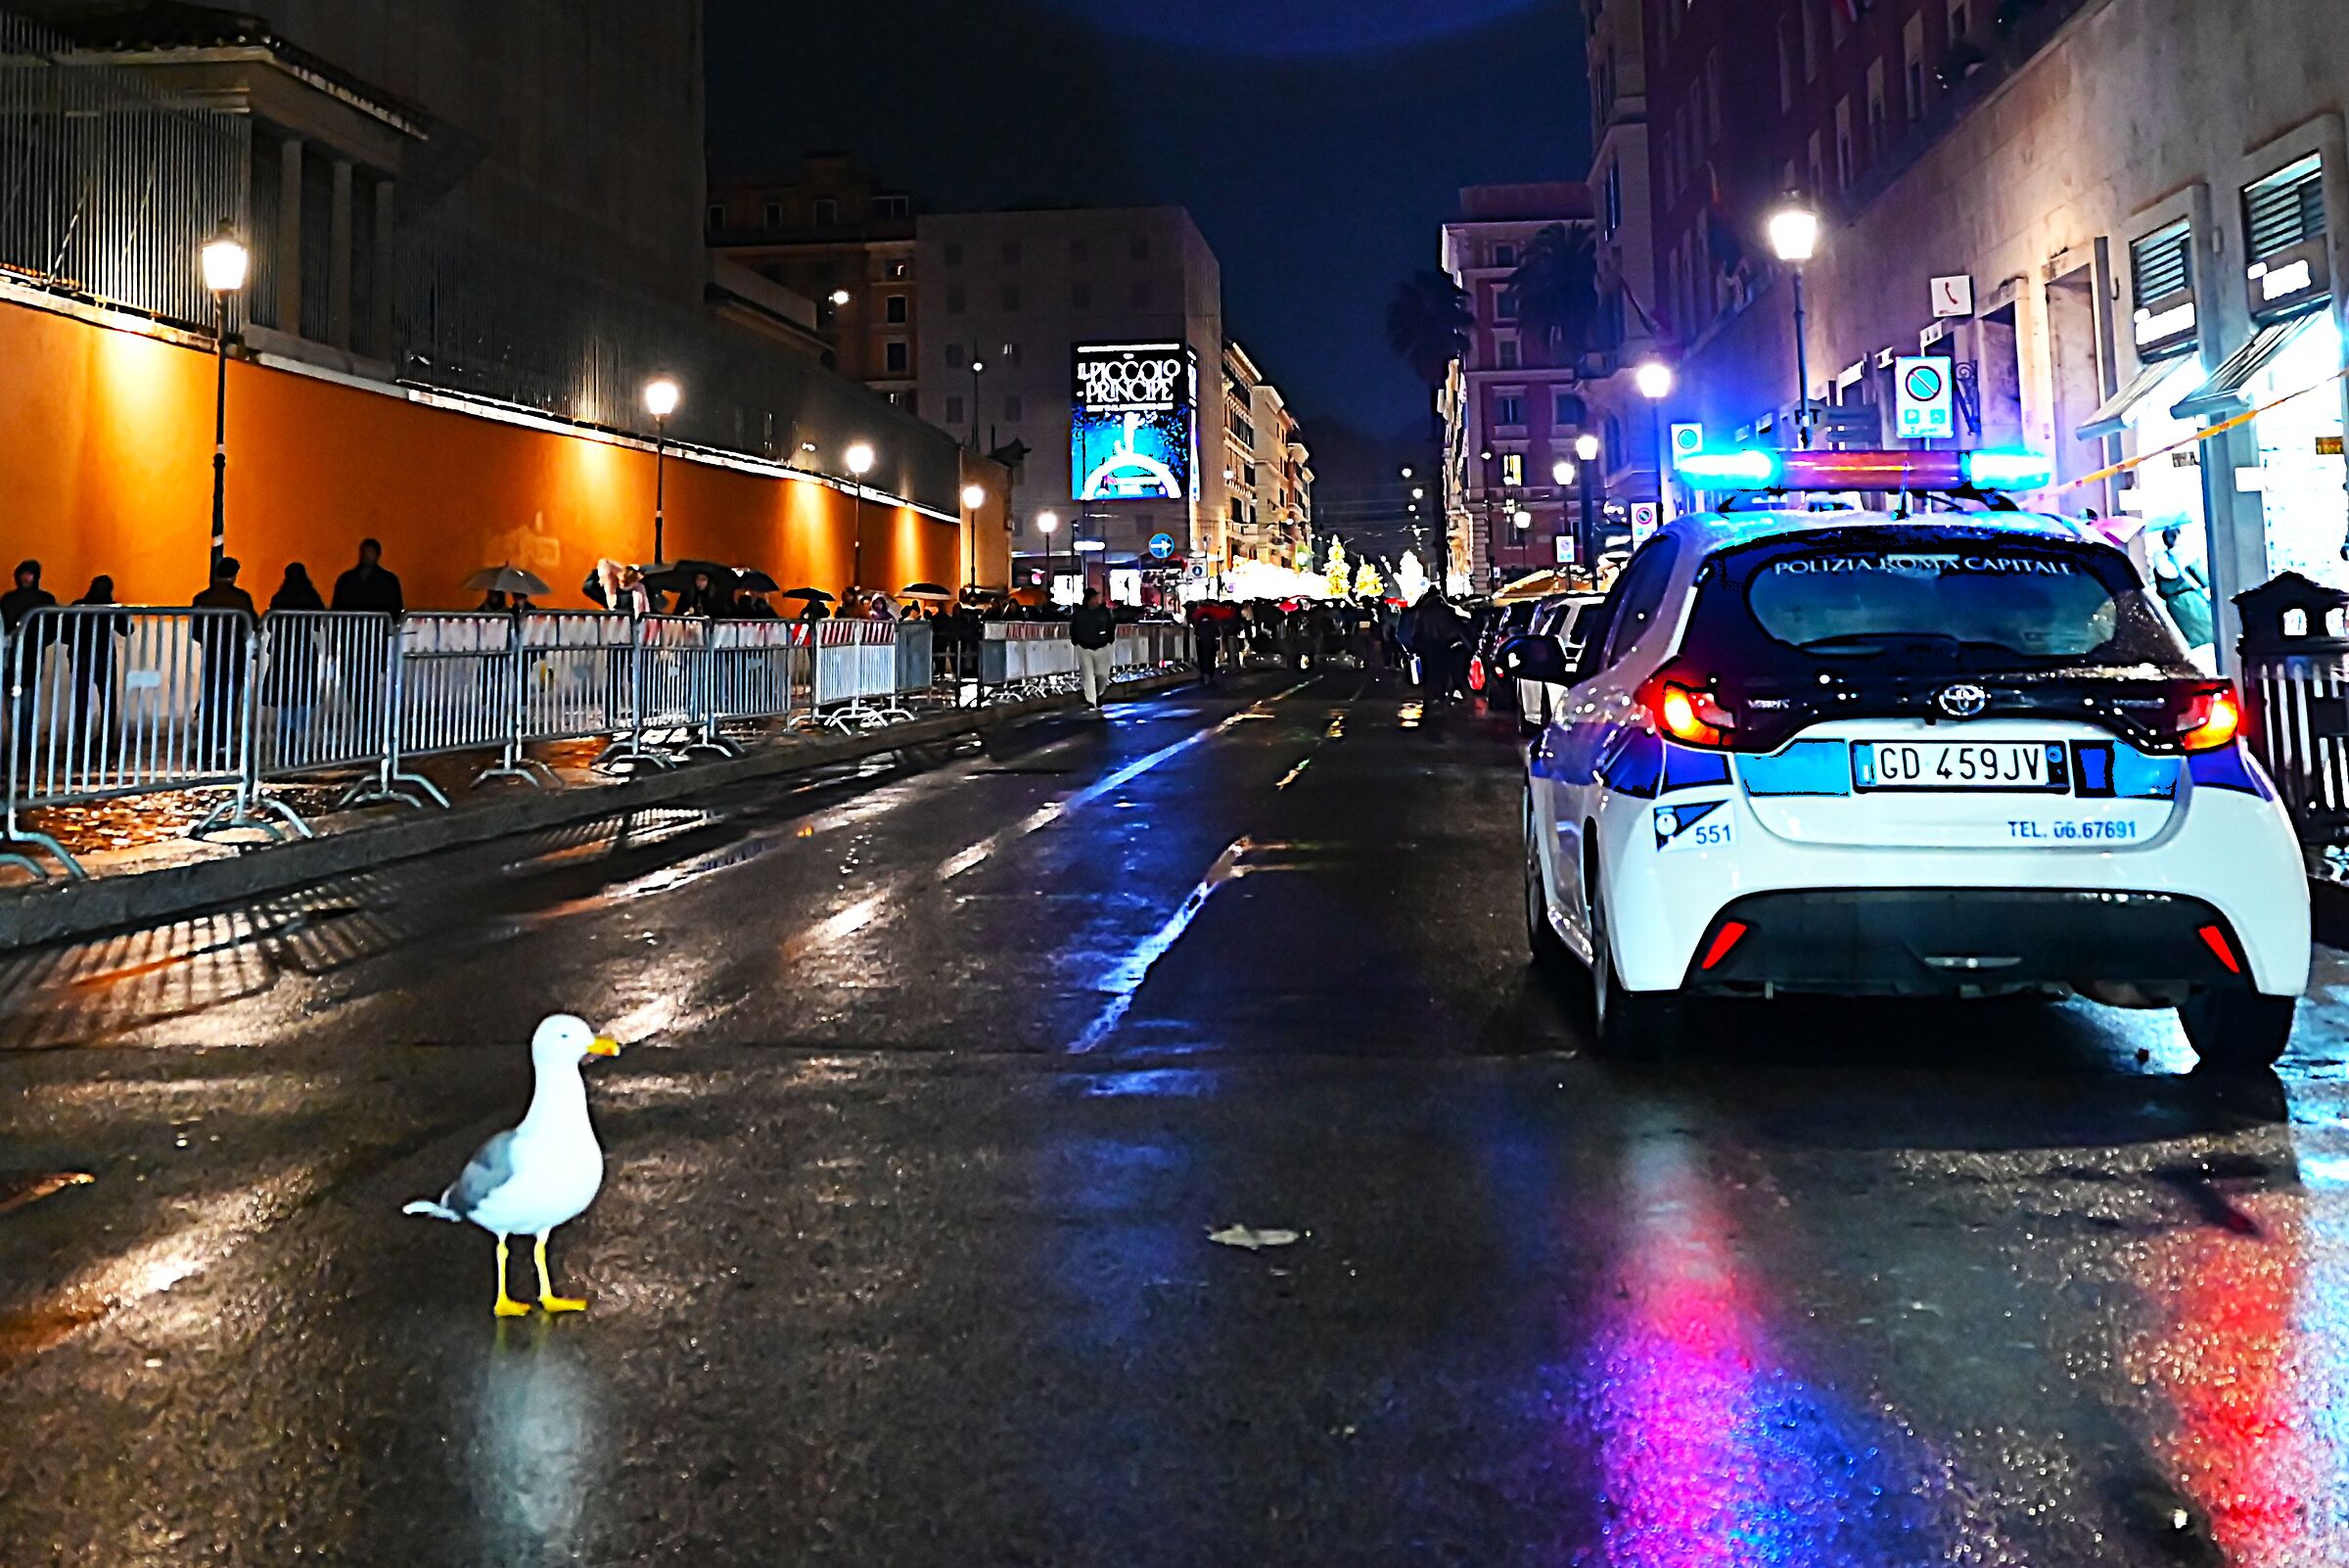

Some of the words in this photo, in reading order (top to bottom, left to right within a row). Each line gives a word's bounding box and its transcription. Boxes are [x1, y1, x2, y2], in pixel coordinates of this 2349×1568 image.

[1089, 359, 1180, 382] PICCOLO
[1086, 377, 1174, 403] PRINCIPE
[1794, 408, 1821, 425] PT
[1774, 558, 1872, 576] POLIZIA
[1880, 747, 1920, 779] GD
[1936, 747, 2039, 780] 459JV
[1695, 824, 1731, 845] 551
[2007, 820, 2048, 838] TEL.
[2053, 820, 2136, 839] 06.67691
